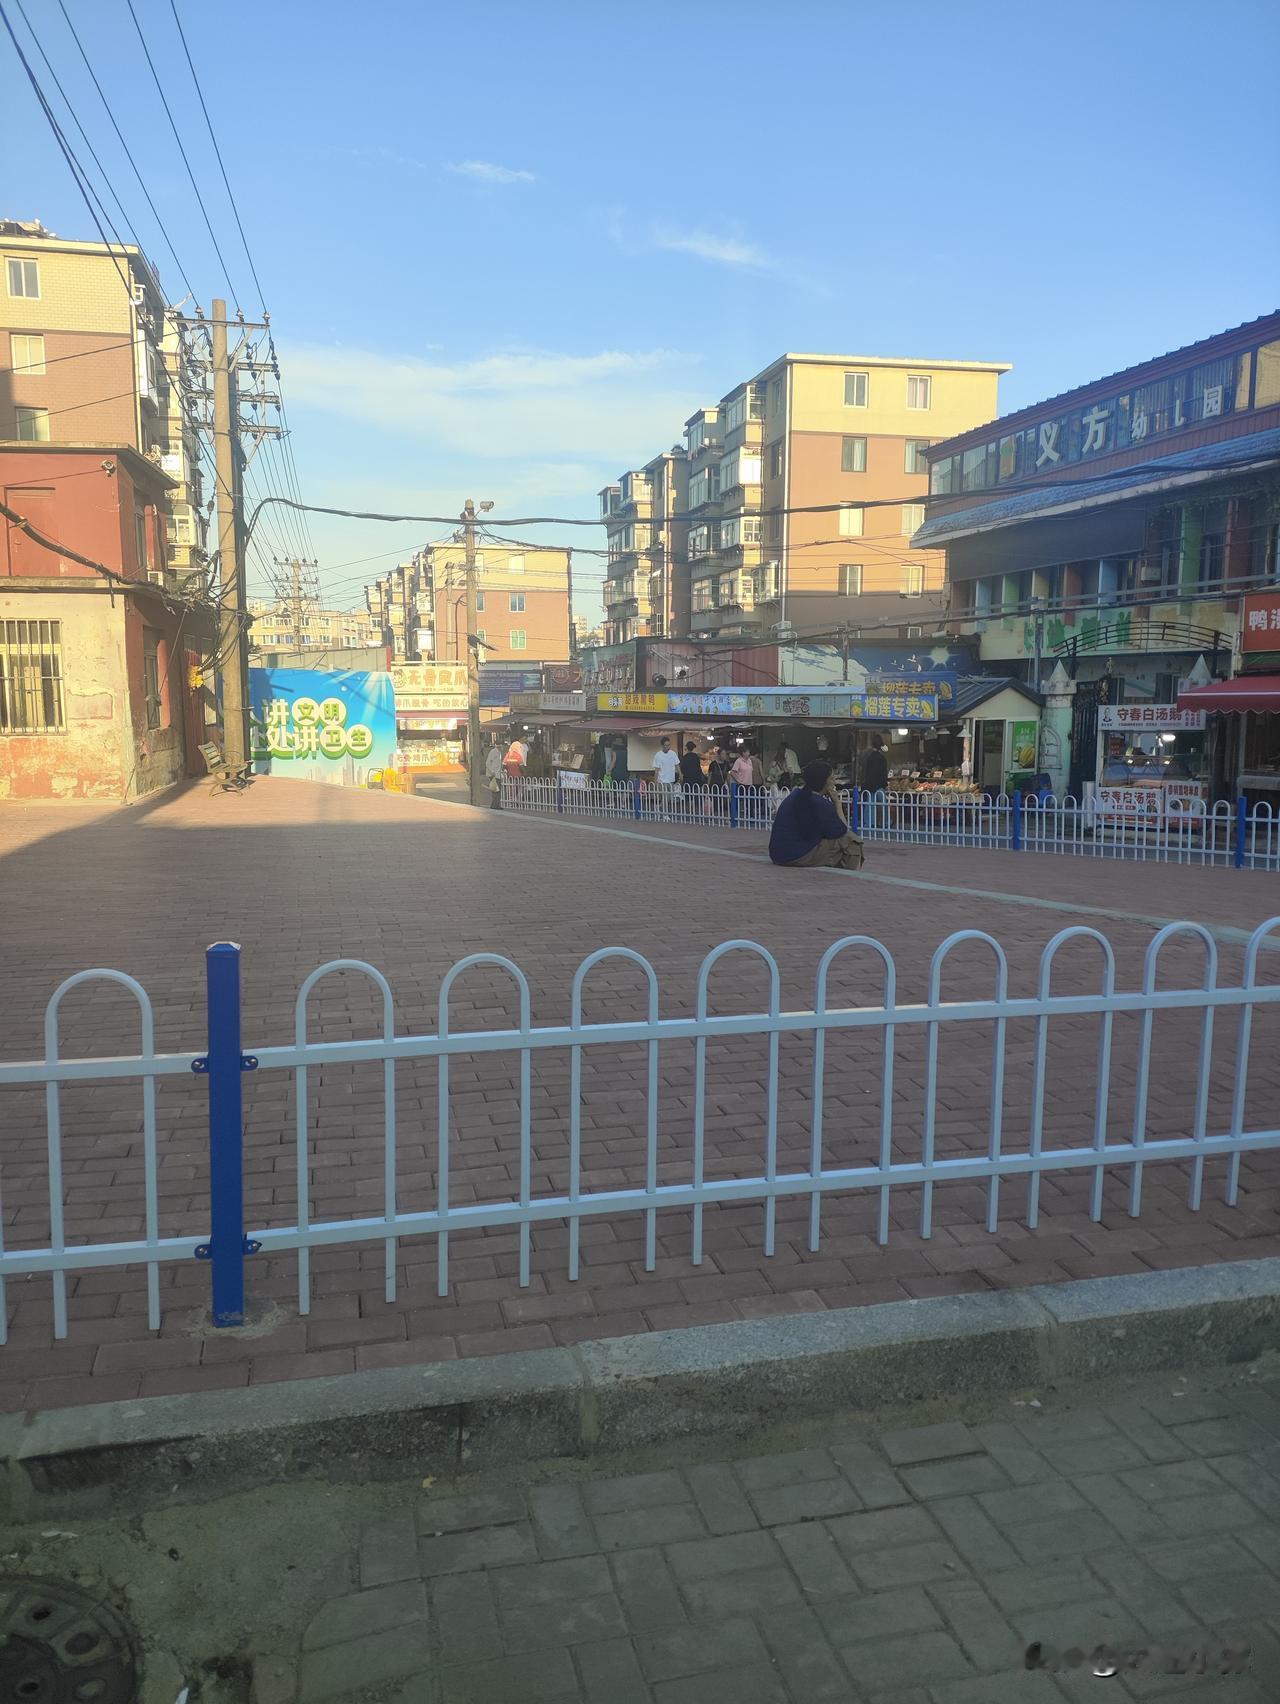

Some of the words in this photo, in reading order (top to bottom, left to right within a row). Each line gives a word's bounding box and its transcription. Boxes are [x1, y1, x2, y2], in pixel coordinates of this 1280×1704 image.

[1036, 385, 1223, 464] 义方幼儿园
[864, 696, 920, 718] 榴莲专卖
